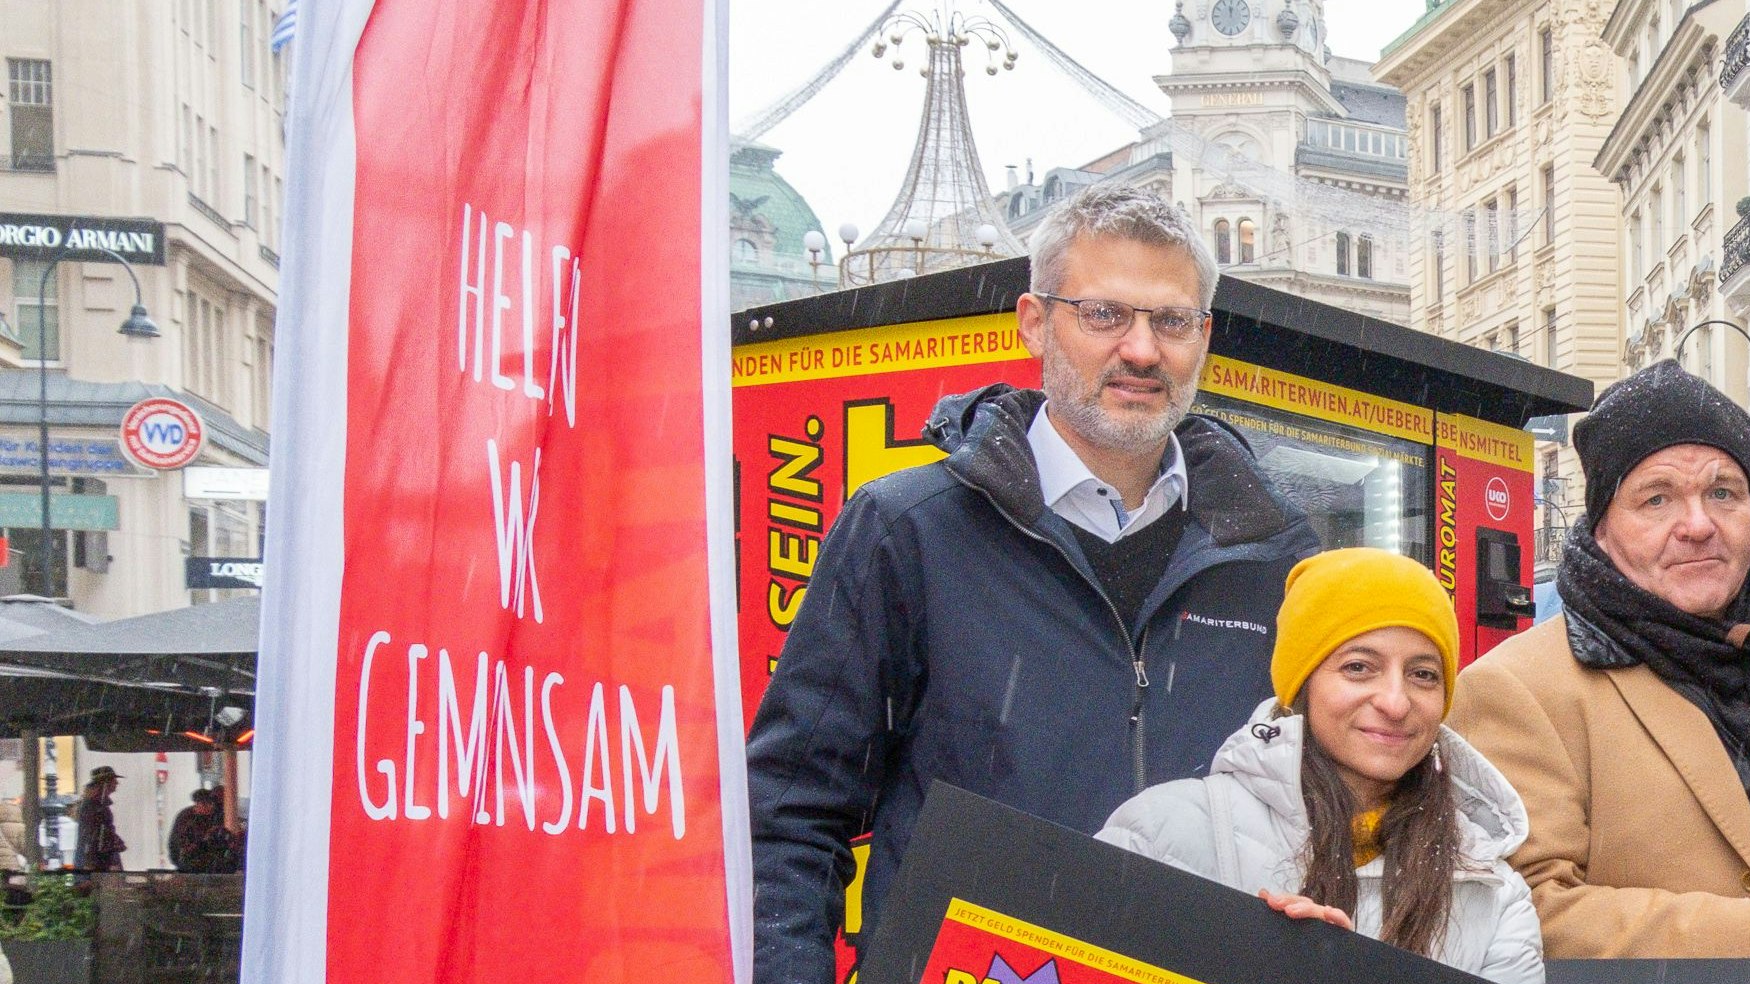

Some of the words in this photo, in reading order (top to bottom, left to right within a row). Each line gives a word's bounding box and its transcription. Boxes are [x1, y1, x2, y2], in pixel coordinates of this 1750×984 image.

[65, 228, 154, 252] ARMANI
[731, 353, 783, 378] NDEN
[789, 345, 825, 372] FÜR
[832, 344, 863, 369] DIE
[870, 328, 1021, 365] SAMARITERBU
[144, 422, 183, 445] VVD
[768, 415, 824, 632] SEIN.
[1439, 455, 1457, 611] UROMAT
[210, 562, 264, 577] LONG
[954, 908, 985, 925] JETZT
[985, 918, 1014, 935] GELD
[1014, 928, 1063, 951] SPENDEN
[1063, 943, 1086, 959] FÜR
[1086, 952, 1105, 966] DIE
